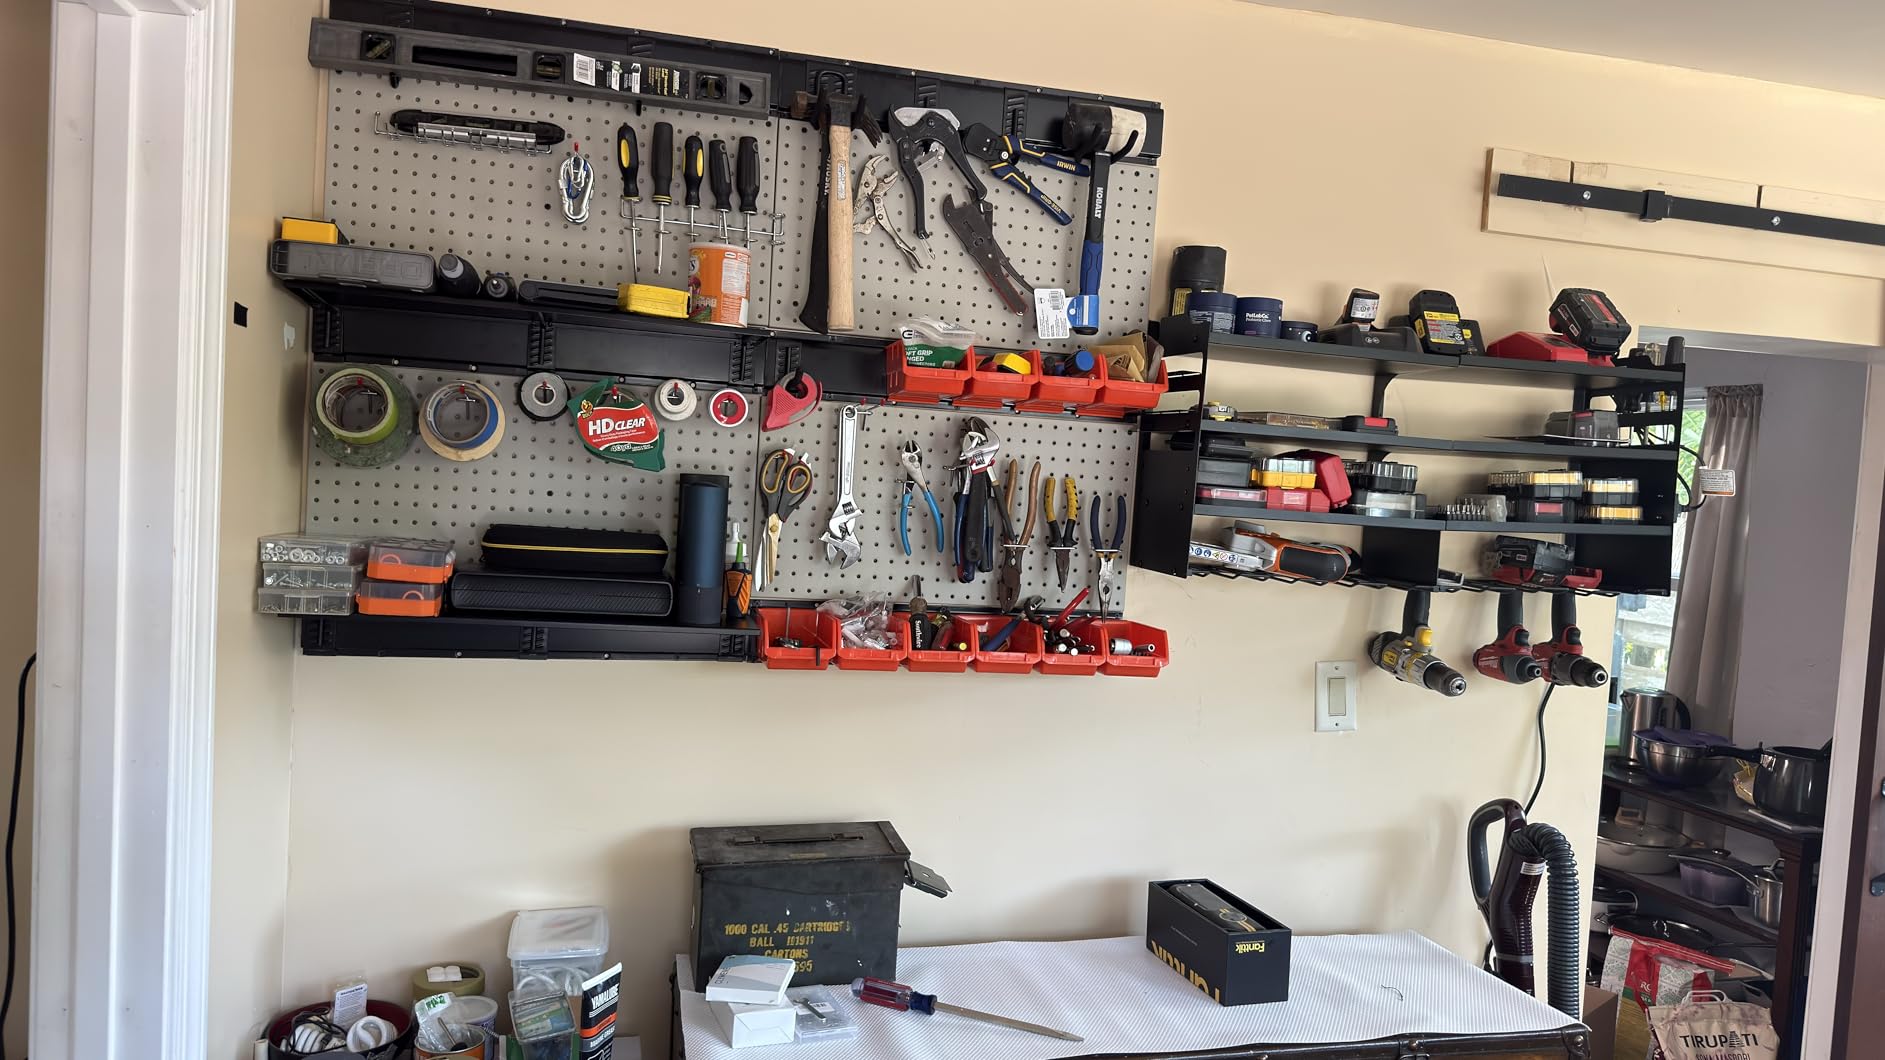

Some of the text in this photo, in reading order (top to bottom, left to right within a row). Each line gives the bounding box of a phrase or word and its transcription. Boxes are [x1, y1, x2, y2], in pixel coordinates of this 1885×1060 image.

[1056, 160, 1077, 172] IRWIN
[1094, 186, 1105, 219] KOBALT
[588, 418, 645, 435] HD CLEAR
[915, 619, 923, 649] Southwire
[724, 923, 747, 936] 1000
[751, 923, 770, 934] CAL
[749, 936, 775, 948] BALL
[1235, 943, 1265, 954] Fanttik
[591, 982, 620, 1010] YAMALUBE
